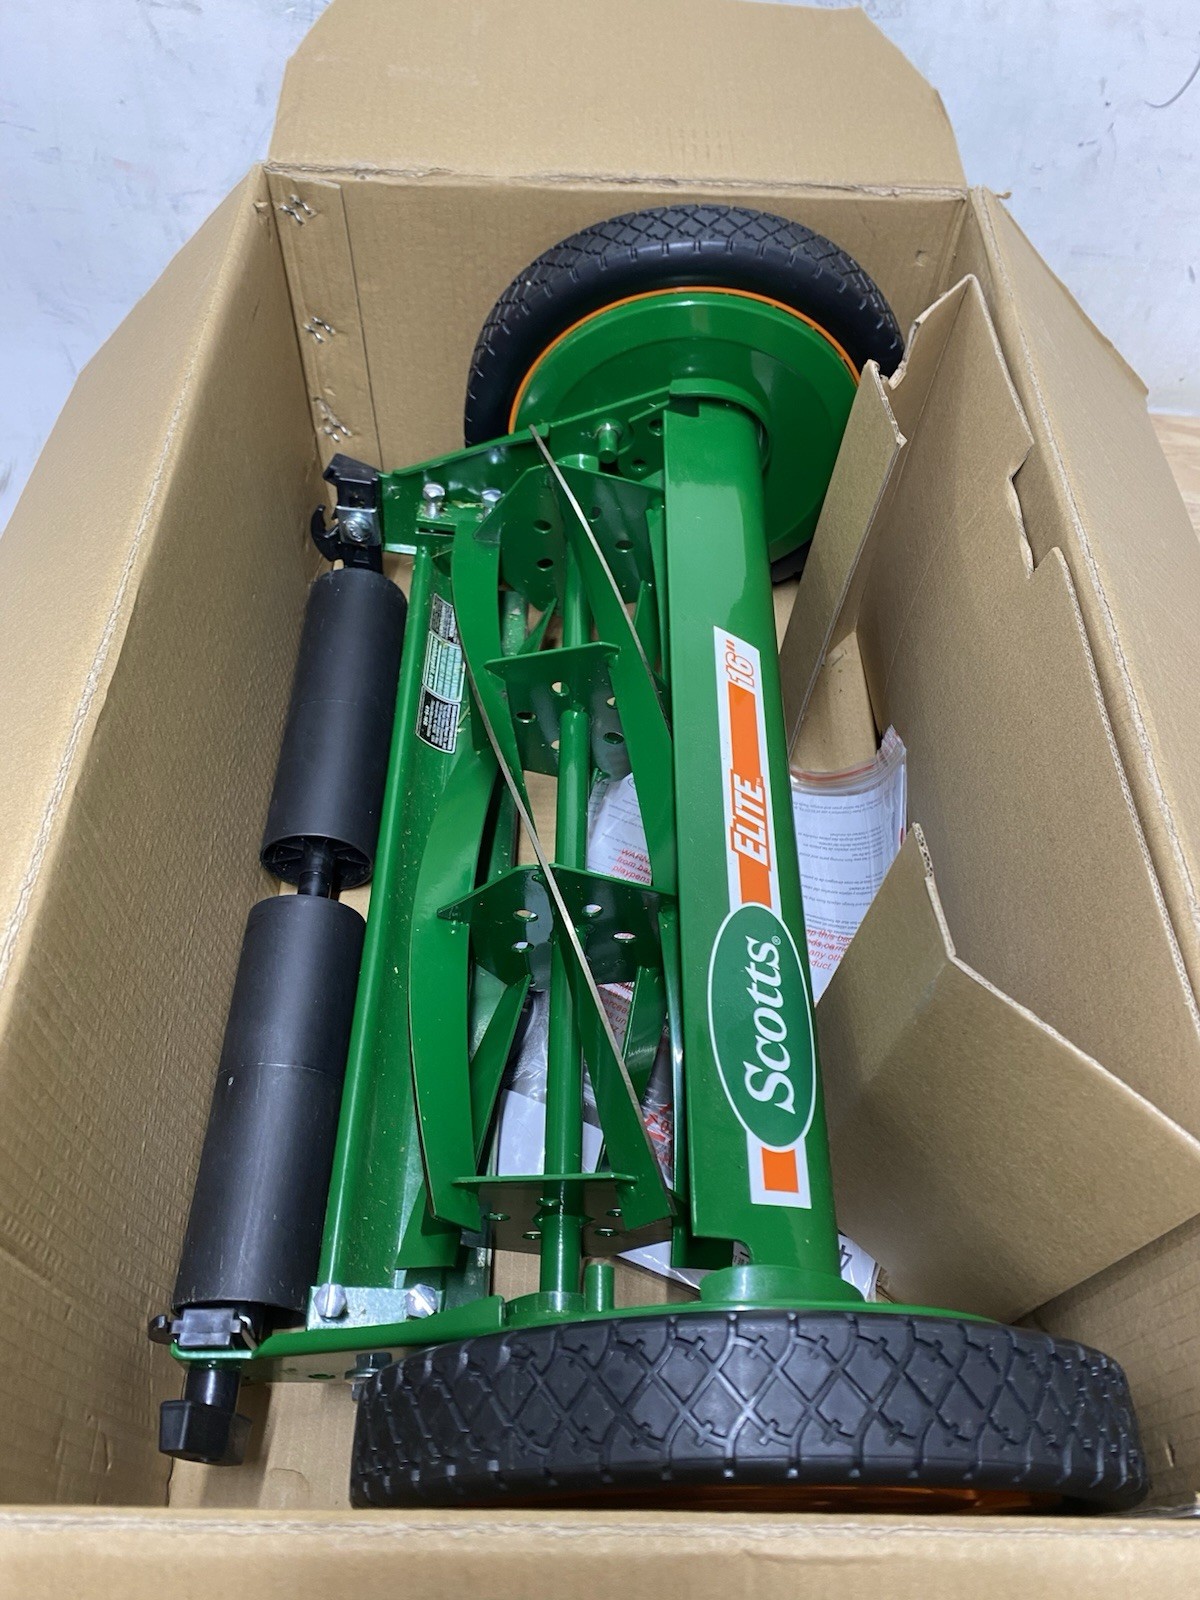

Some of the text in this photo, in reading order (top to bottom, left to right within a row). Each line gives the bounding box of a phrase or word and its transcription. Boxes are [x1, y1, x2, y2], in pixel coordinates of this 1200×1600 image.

[732, 774, 768, 863] ELITE
[809, 950, 826, 960] any
[743, 935, 797, 1115] Scotts
